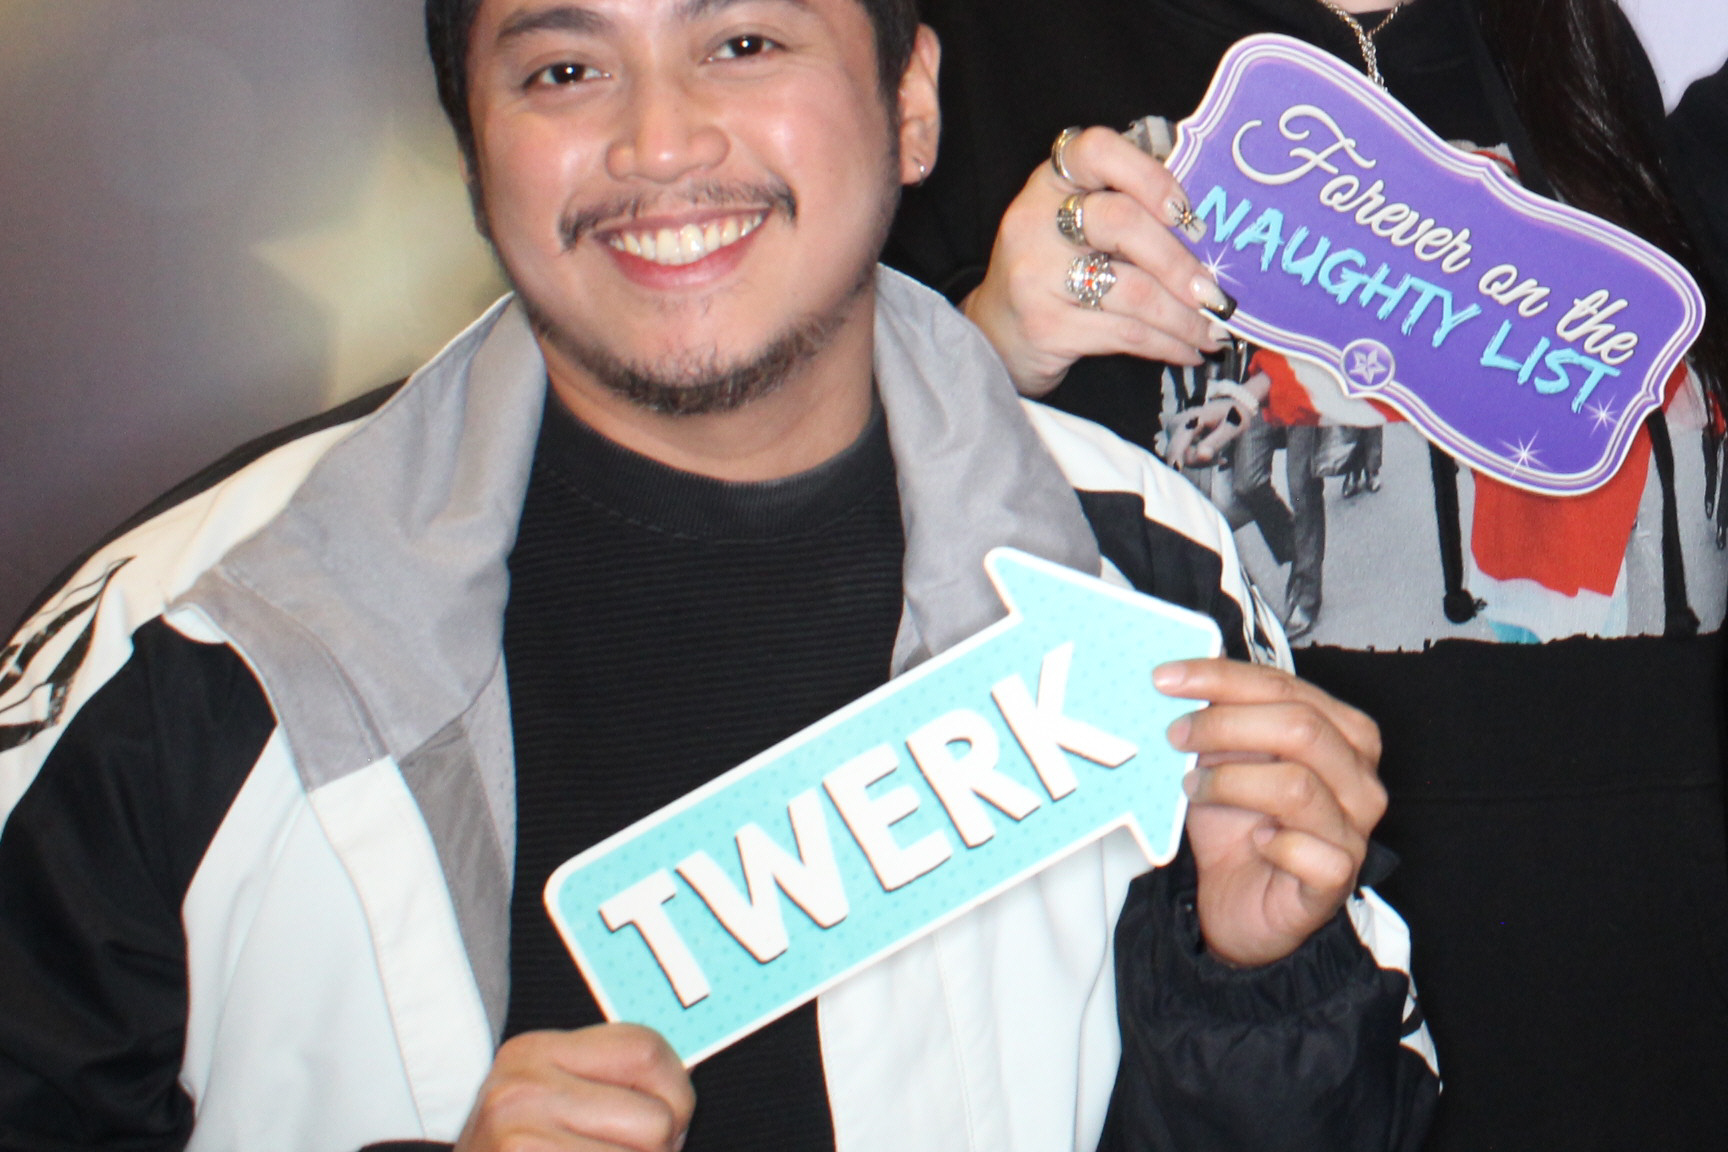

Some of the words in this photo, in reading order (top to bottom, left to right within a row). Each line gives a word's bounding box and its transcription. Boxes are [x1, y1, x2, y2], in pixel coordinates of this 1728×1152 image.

[1194, 185, 1481, 347] NAUGHTY
[1480, 320, 1620, 414] LIST
[1232, 104, 1470, 273] Forever
[1479, 255, 1551, 317] on
[1556, 289, 1639, 366] the
[598, 640, 1138, 1009] TWERK
